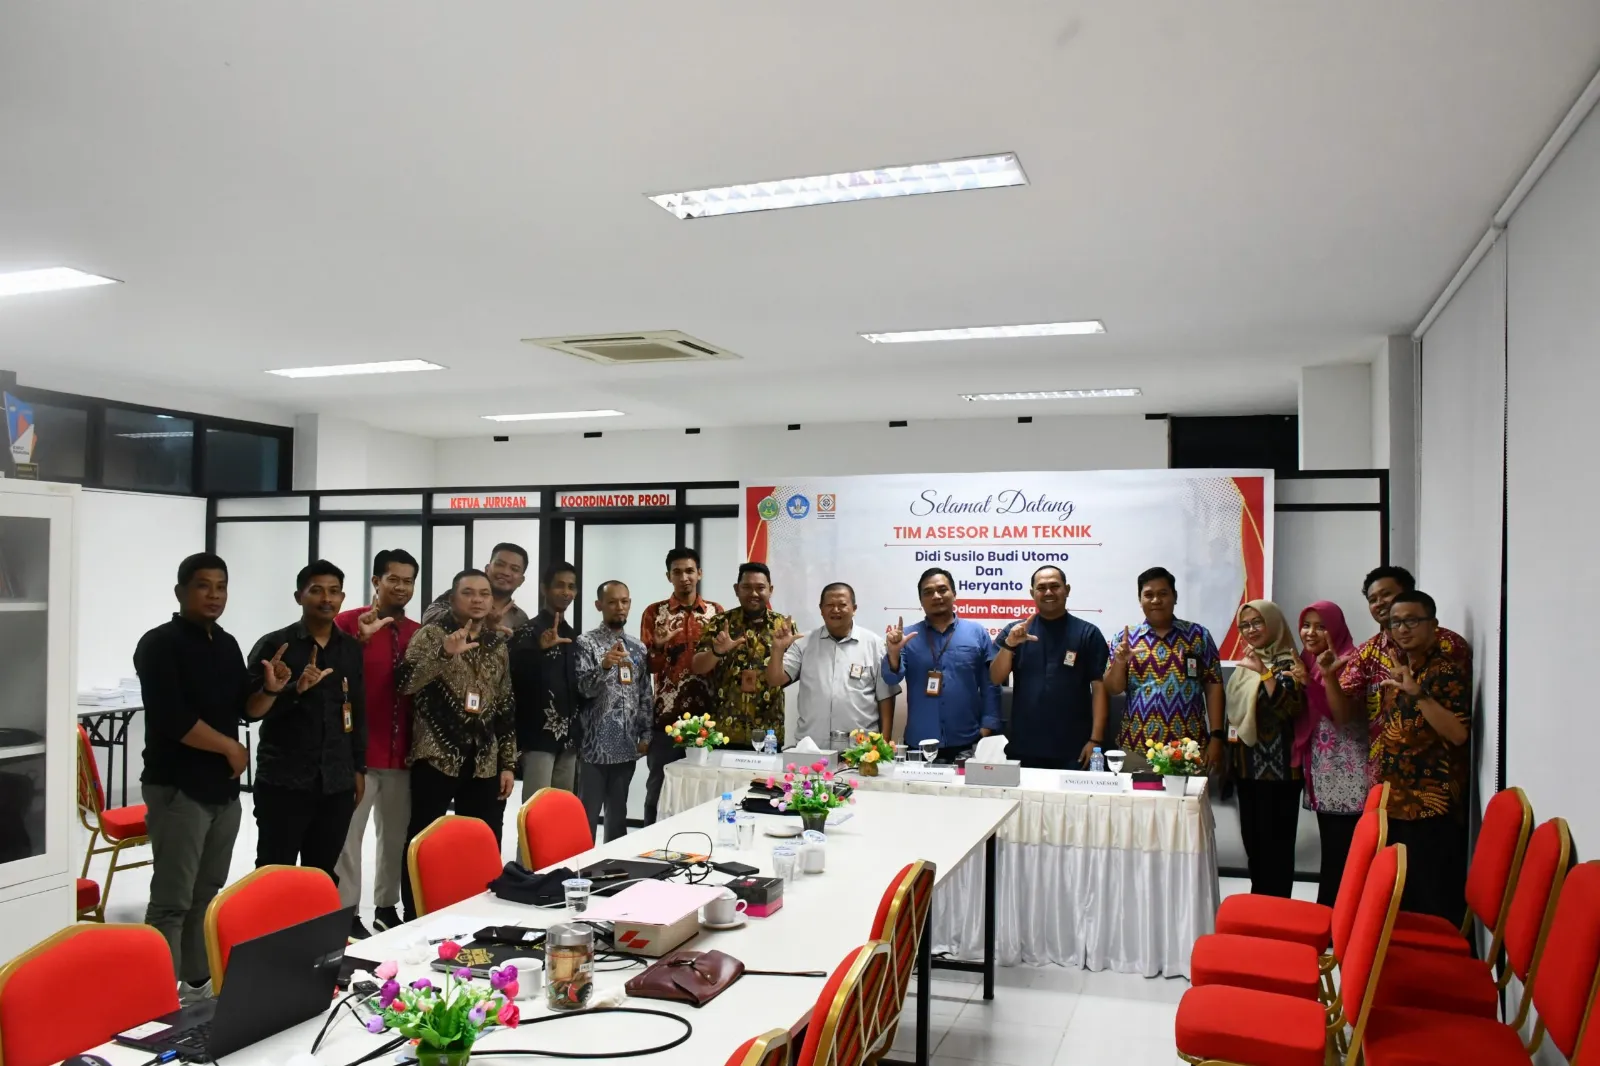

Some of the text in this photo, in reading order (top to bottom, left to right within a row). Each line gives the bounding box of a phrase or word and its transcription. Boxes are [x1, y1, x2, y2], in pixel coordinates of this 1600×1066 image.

[450, 496, 527, 509] KETUA JURUSAN
[560, 493, 670, 508] KOORDINATOR PRODI
[910, 488, 1076, 522] Selamat Datang
[893, 525, 1092, 539] TIM ASESOR LAM TEKNIK
[915, 550, 1069, 562] Didi Susilo Budi Utomo
[975, 566, 1003, 576] Dan
[959, 579, 1023, 594] Heryanto
[990, 604, 1036, 617] Rangka
